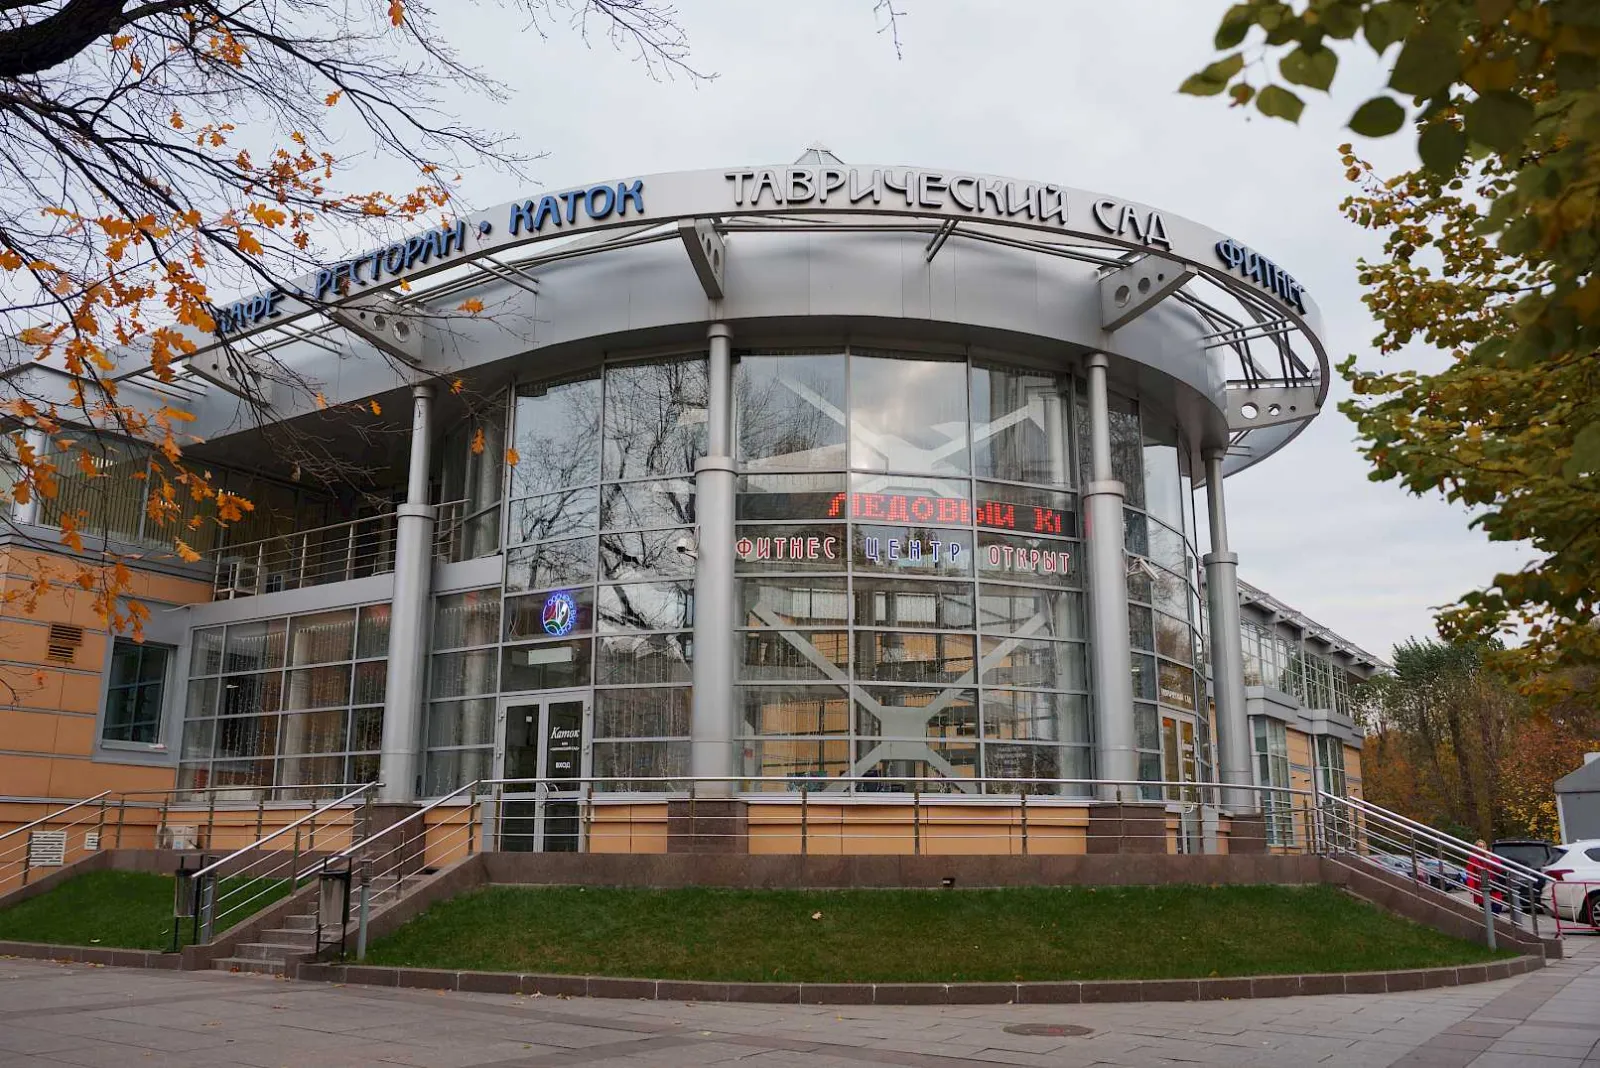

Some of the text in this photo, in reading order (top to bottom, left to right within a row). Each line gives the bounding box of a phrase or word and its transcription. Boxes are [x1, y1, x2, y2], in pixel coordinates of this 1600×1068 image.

[314, 218, 465, 301] РЕСТОРАН
[509, 180, 644, 235] КАТОК
[724, 168, 1174, 252] ТАВРИЧЕСКИЙ САД
[1215, 238, 1307, 315] ФИТНЕС
[736, 537, 1070, 574] ФИТНЕС ЦЕНТР ОТКРЫТ
[550, 726, 580, 739] Каток
